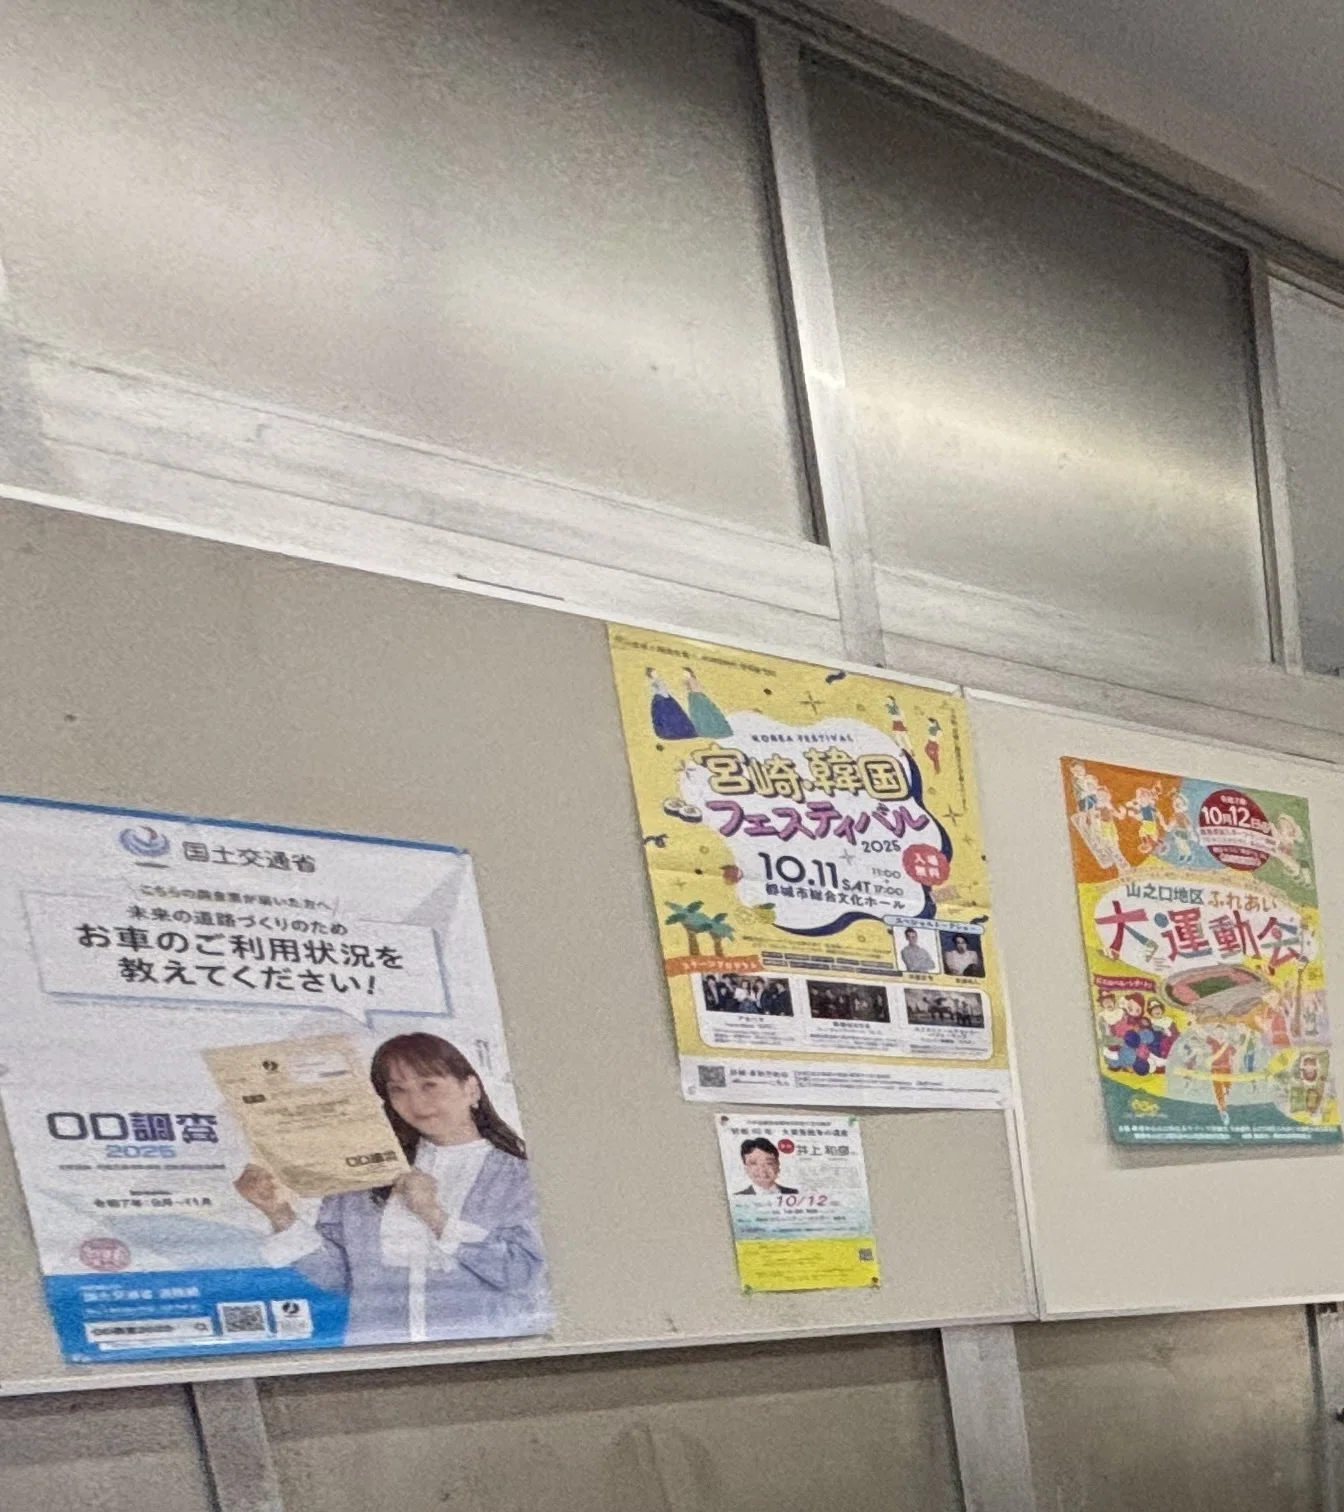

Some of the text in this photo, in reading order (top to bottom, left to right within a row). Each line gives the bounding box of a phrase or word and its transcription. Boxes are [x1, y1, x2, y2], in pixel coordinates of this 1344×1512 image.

[751, 734, 855, 743] KOREA FESTIVAL
[704, 799, 931, 846] フェスティバル
[182, 841, 316, 873] 国土交通省
[861, 840, 901, 853] 2025
[758, 851, 872, 893] 10.11 SAT
[765, 883, 906, 909] 都城市総合文化ホール
[1126, 883, 1278, 912] 山之口地区 ふれあい
[126, 904, 348, 936] 未来の道路づくりのため
[1094, 900, 1301, 970] 大運動会
[74, 923, 404, 970] お車のご利用状況を
[46, 1112, 219, 1144] OD調査
[105, 1144, 177, 1158] 2025
